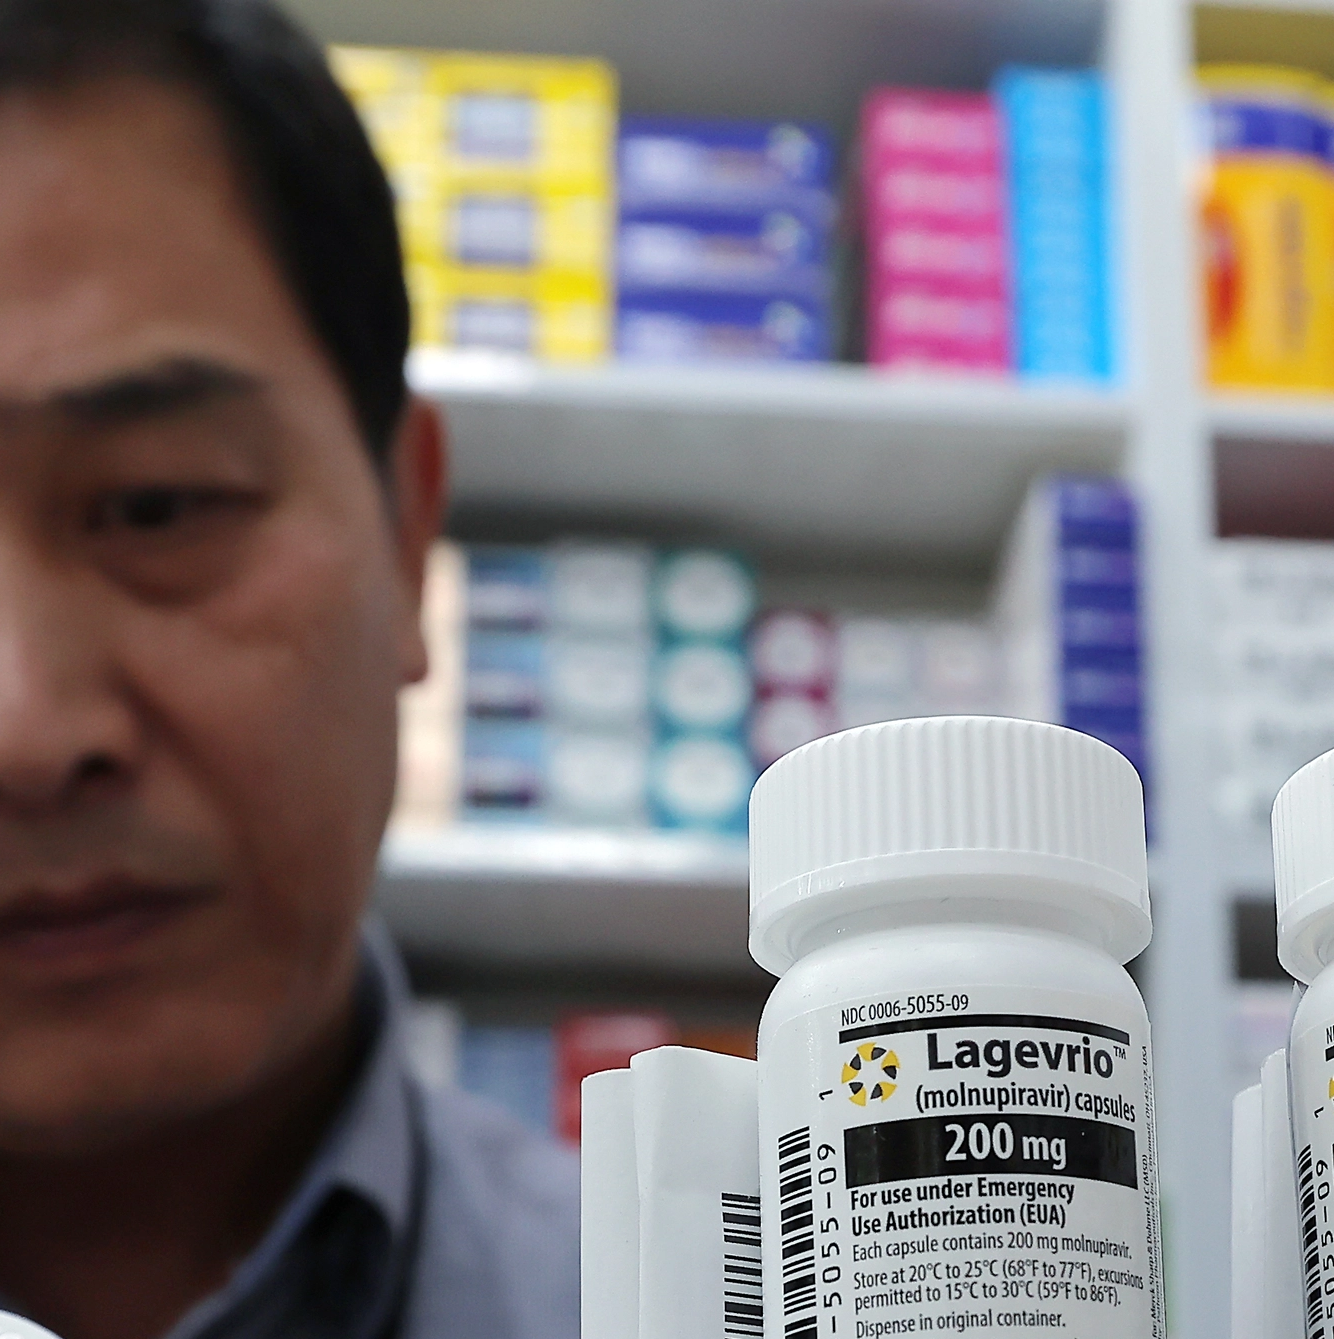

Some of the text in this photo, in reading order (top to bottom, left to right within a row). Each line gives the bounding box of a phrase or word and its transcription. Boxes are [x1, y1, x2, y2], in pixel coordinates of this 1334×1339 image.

[841, 994, 969, 1026] NDC 0006-5055-09
[916, 1083, 1136, 1122] (molnupiravir) capsules
[945, 1122, 1066, 1170] 200 mg
[851, 1177, 1075, 1210] For use under Emergency
[852, 1203, 1066, 1236] Use Authorization (EUA)
